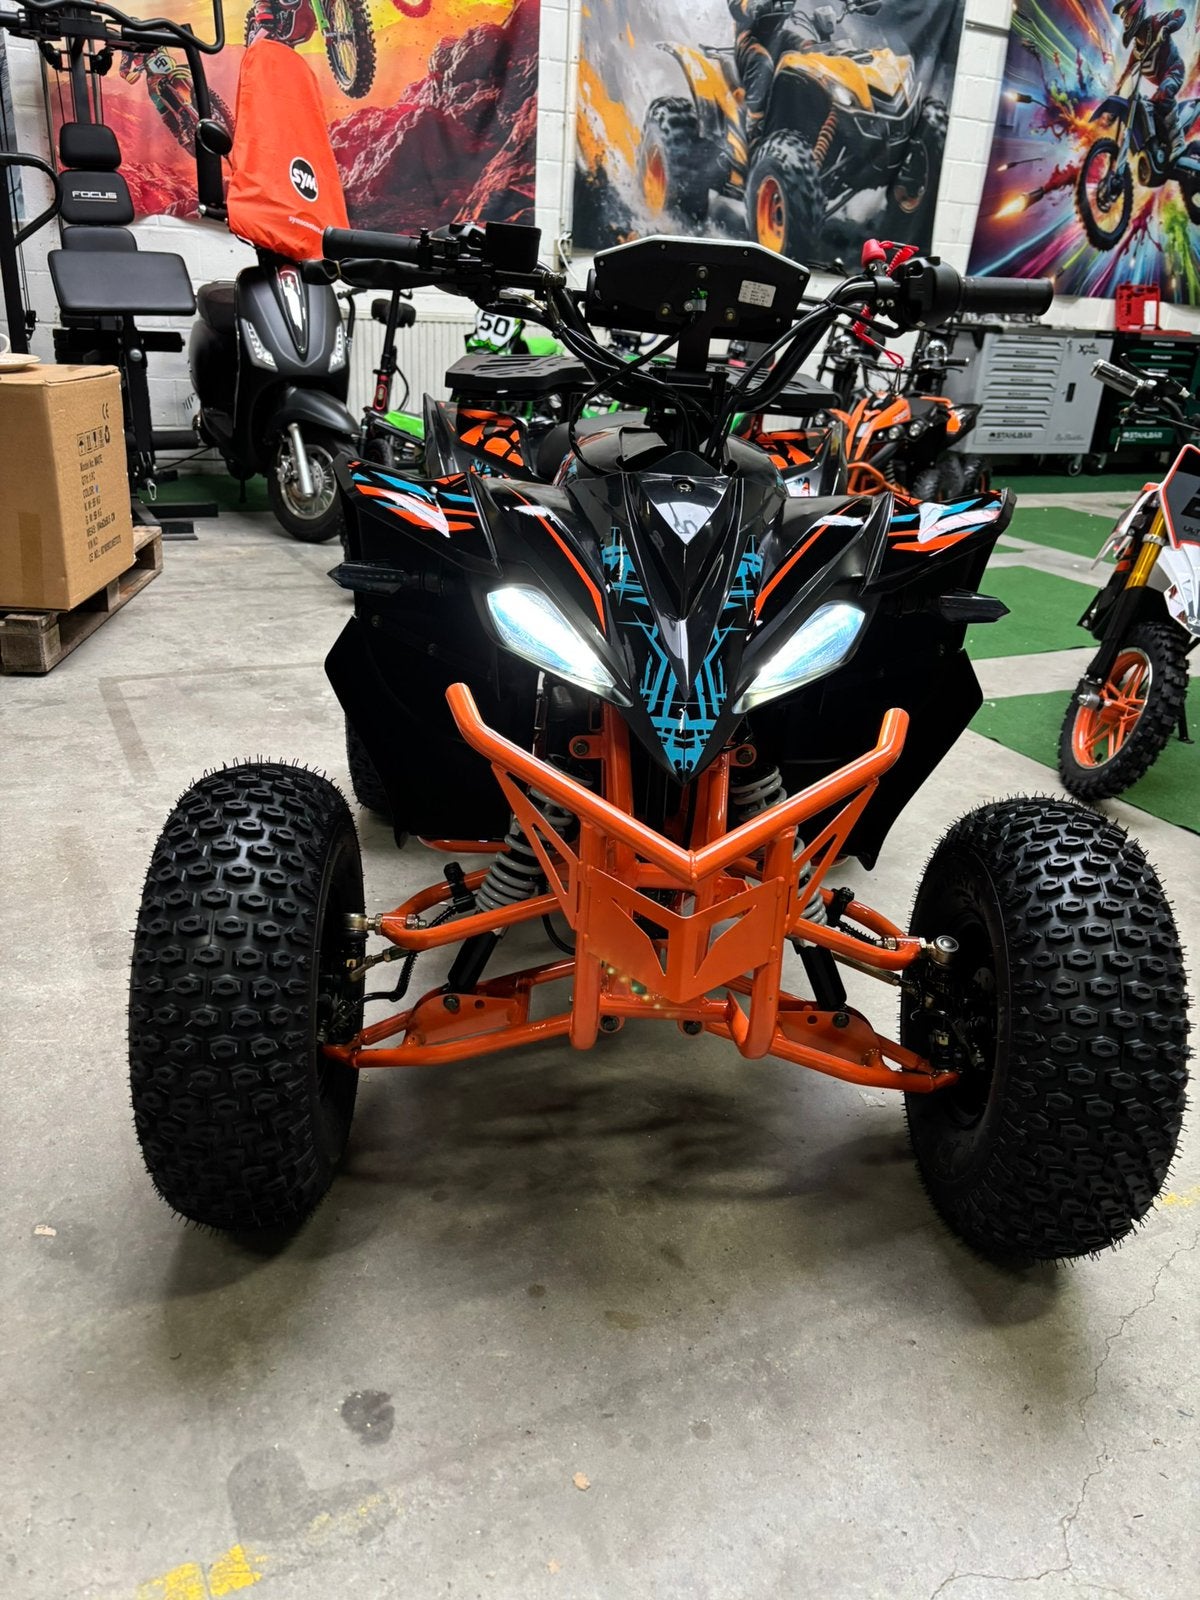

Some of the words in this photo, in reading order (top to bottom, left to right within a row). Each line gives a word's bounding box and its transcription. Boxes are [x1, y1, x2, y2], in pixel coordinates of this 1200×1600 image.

[292, 167, 317, 192] SYM
[72, 190, 117, 199] FOCUS
[479, 311, 510, 337] 50
